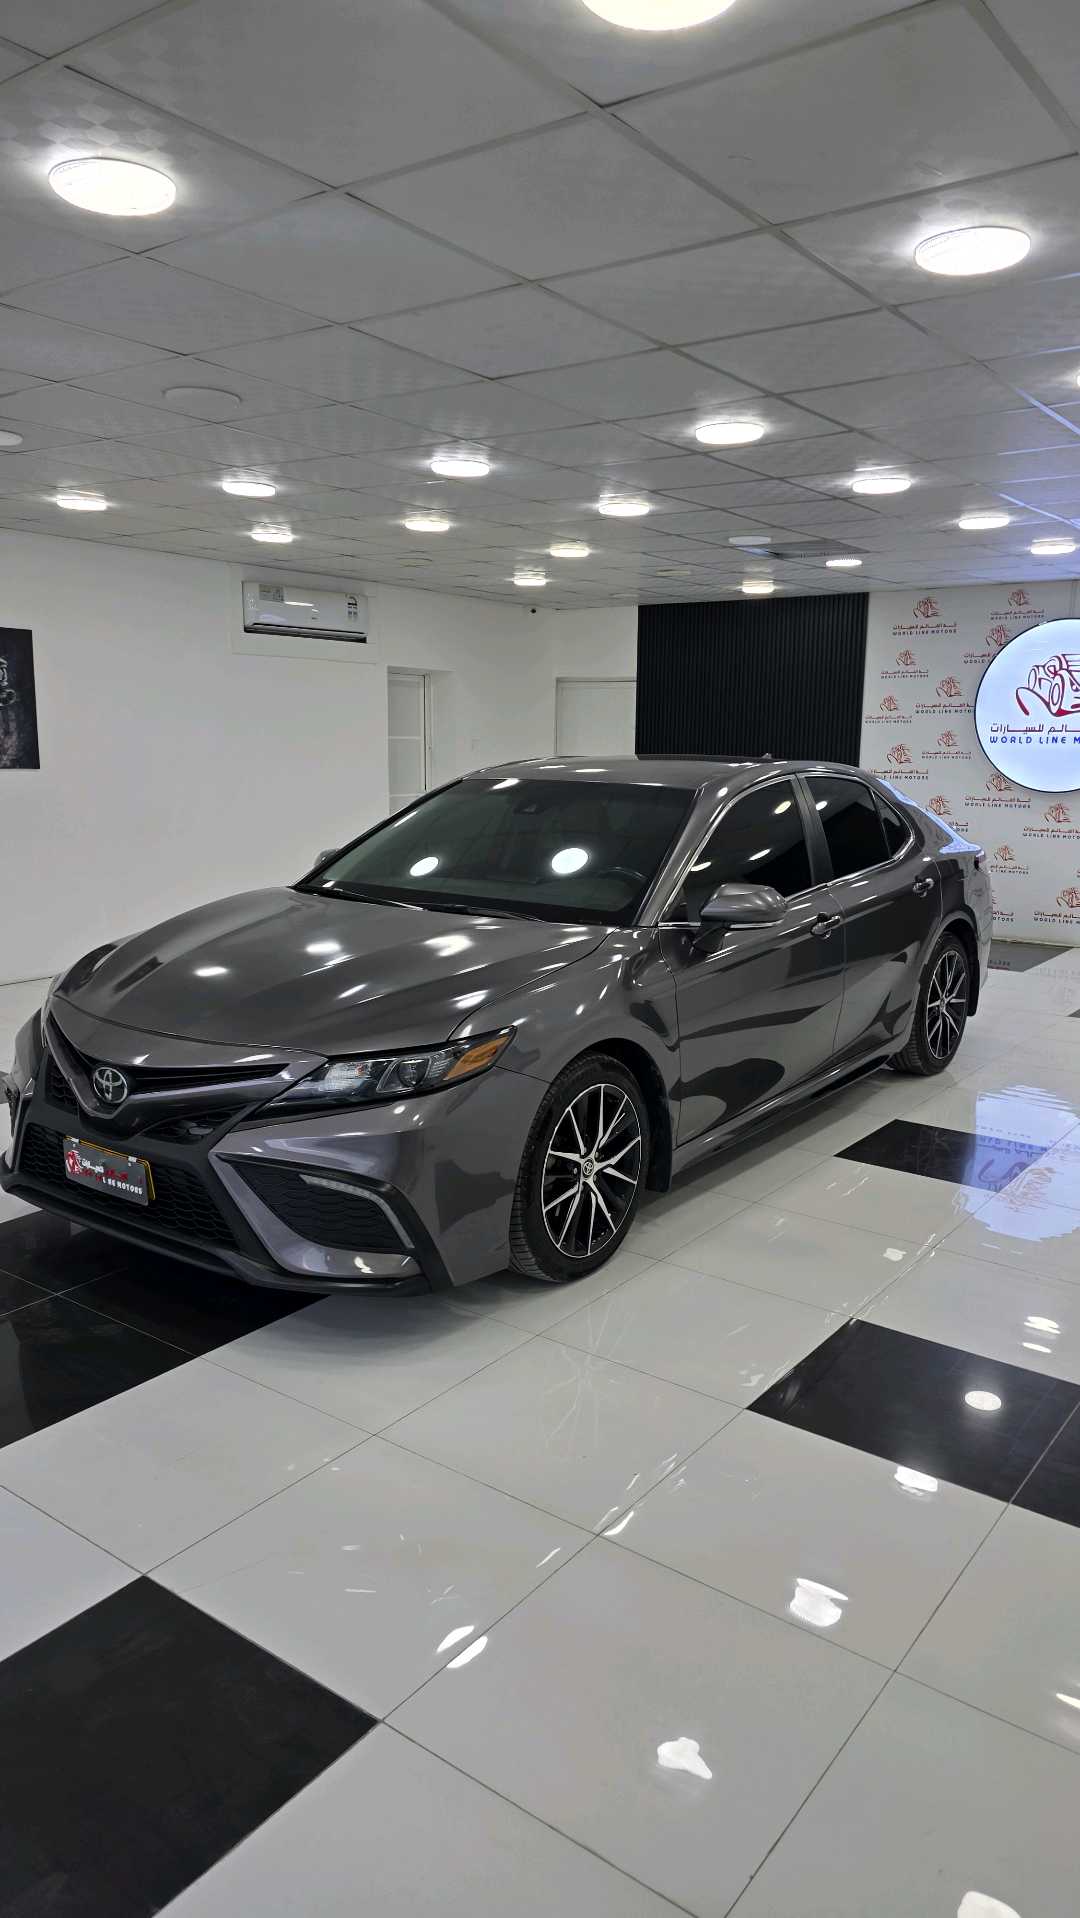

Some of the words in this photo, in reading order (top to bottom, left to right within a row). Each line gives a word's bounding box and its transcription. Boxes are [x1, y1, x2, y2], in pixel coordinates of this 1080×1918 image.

[989, 736, 1032, 744] WORLD
[1039, 736, 1067, 744] LINE
[117, 1181, 143, 1195] MOTORS
